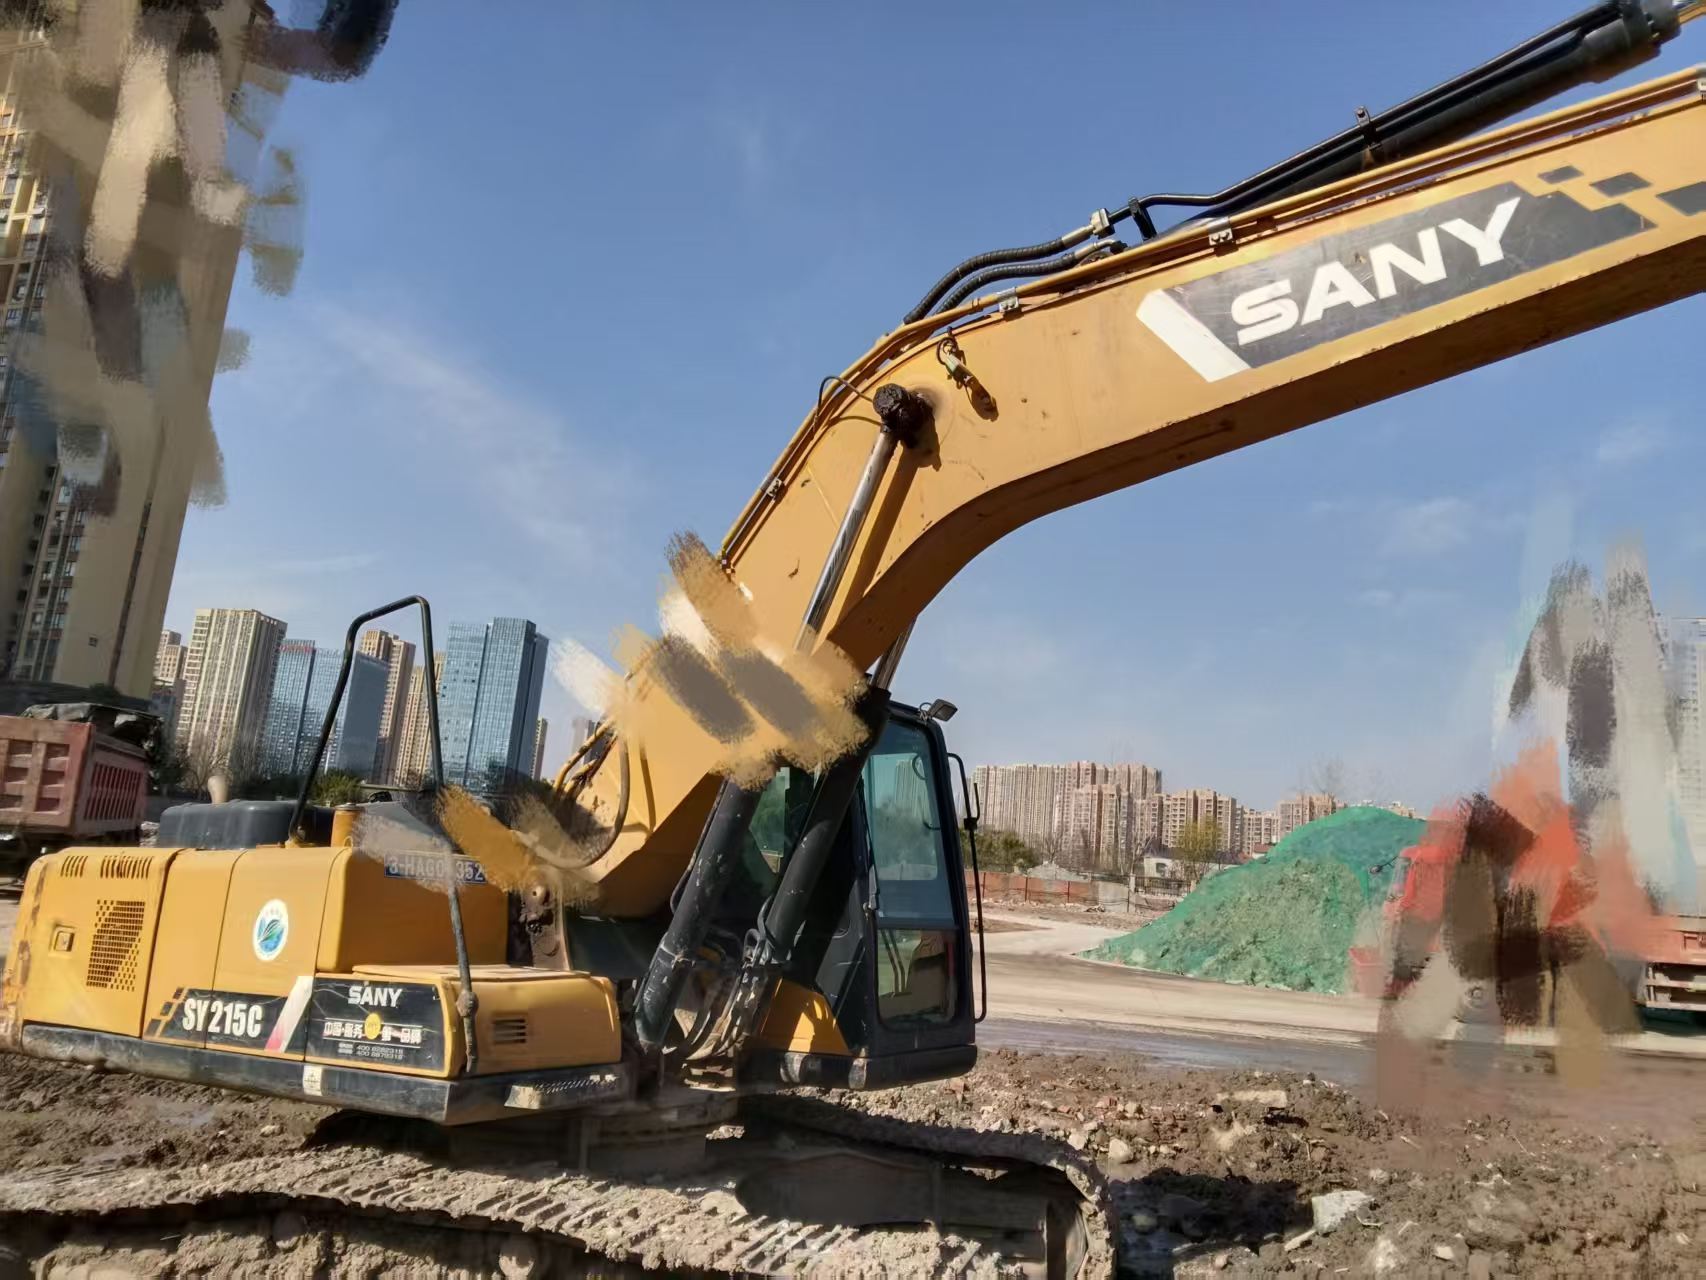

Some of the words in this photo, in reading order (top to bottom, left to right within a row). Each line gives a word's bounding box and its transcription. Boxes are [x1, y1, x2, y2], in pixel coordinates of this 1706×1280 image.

[1231, 197, 1520, 346] SANY
[347, 984, 403, 1008] SANY
[182, 998, 263, 1038] SY215C
